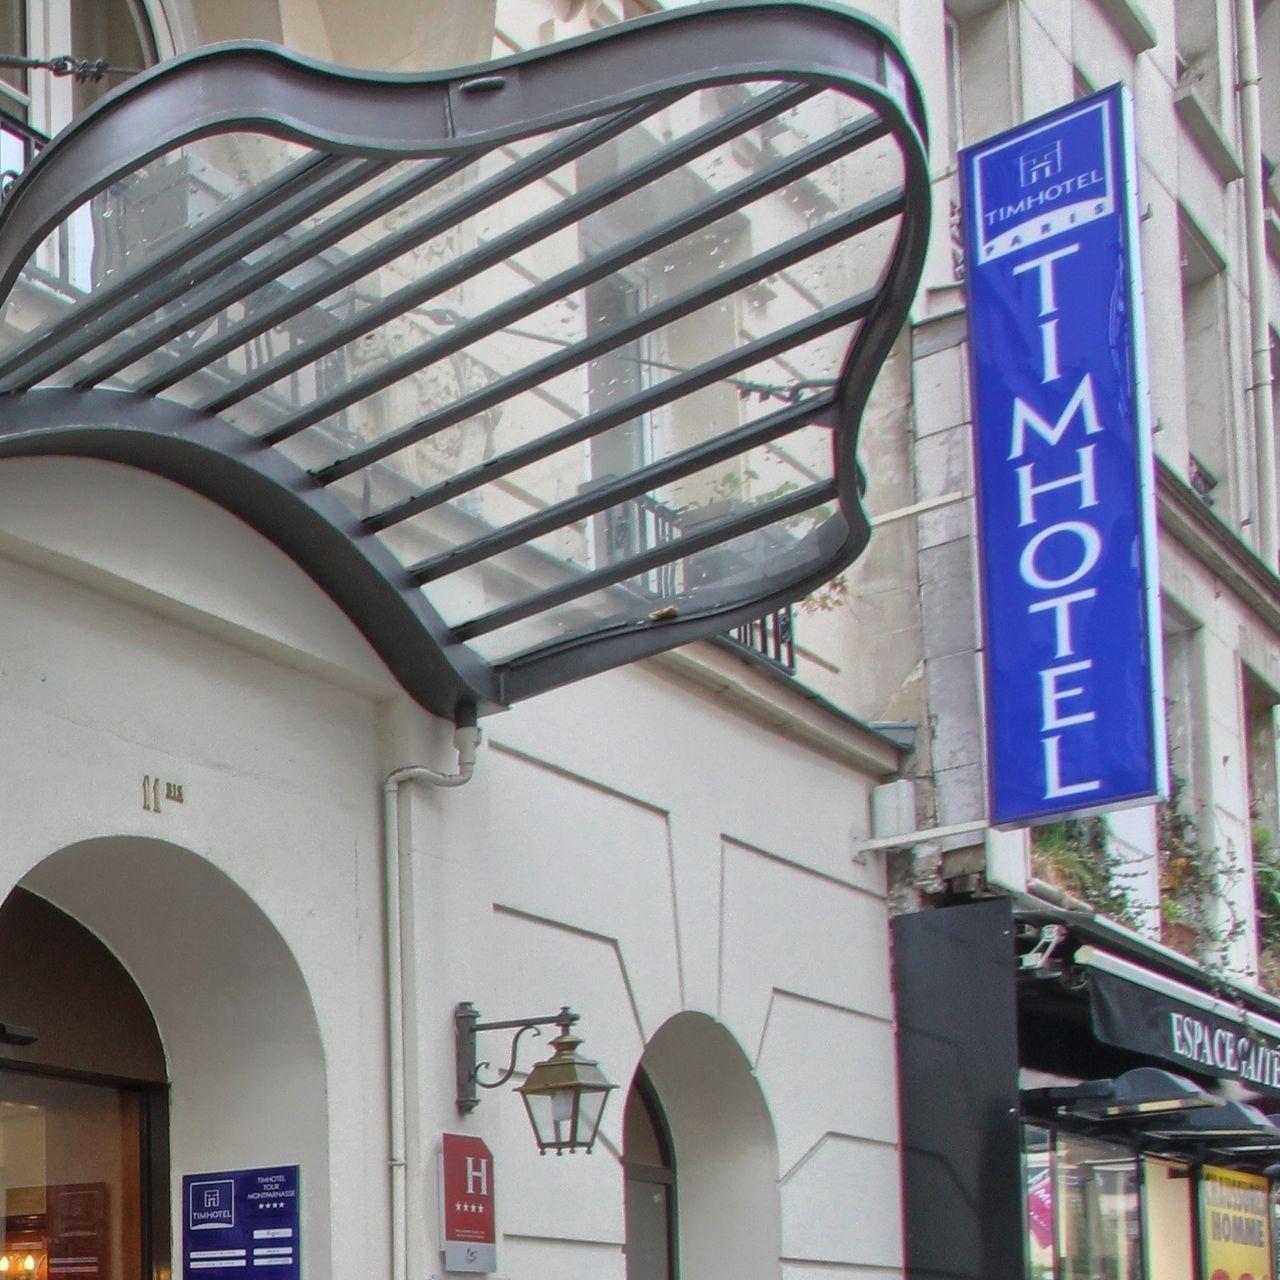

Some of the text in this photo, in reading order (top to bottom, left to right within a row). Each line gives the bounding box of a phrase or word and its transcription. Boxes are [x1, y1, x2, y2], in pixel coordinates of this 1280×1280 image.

[984, 169, 1105, 226] TIMHOTEL
[985, 202, 1105, 257] PARIS
[1007, 242, 1104, 799] TIMHOTEL
[1169, 1011, 1239, 1072] ESPACE
[247, 1189, 296, 1200] MONTPARNASSE
[257, 1174, 286, 1184] TIMHOTEL
[263, 1183, 280, 1191] TOUR
[465, 1156, 488, 1196] H
[192, 1210, 232, 1220] TIMHOTEL
